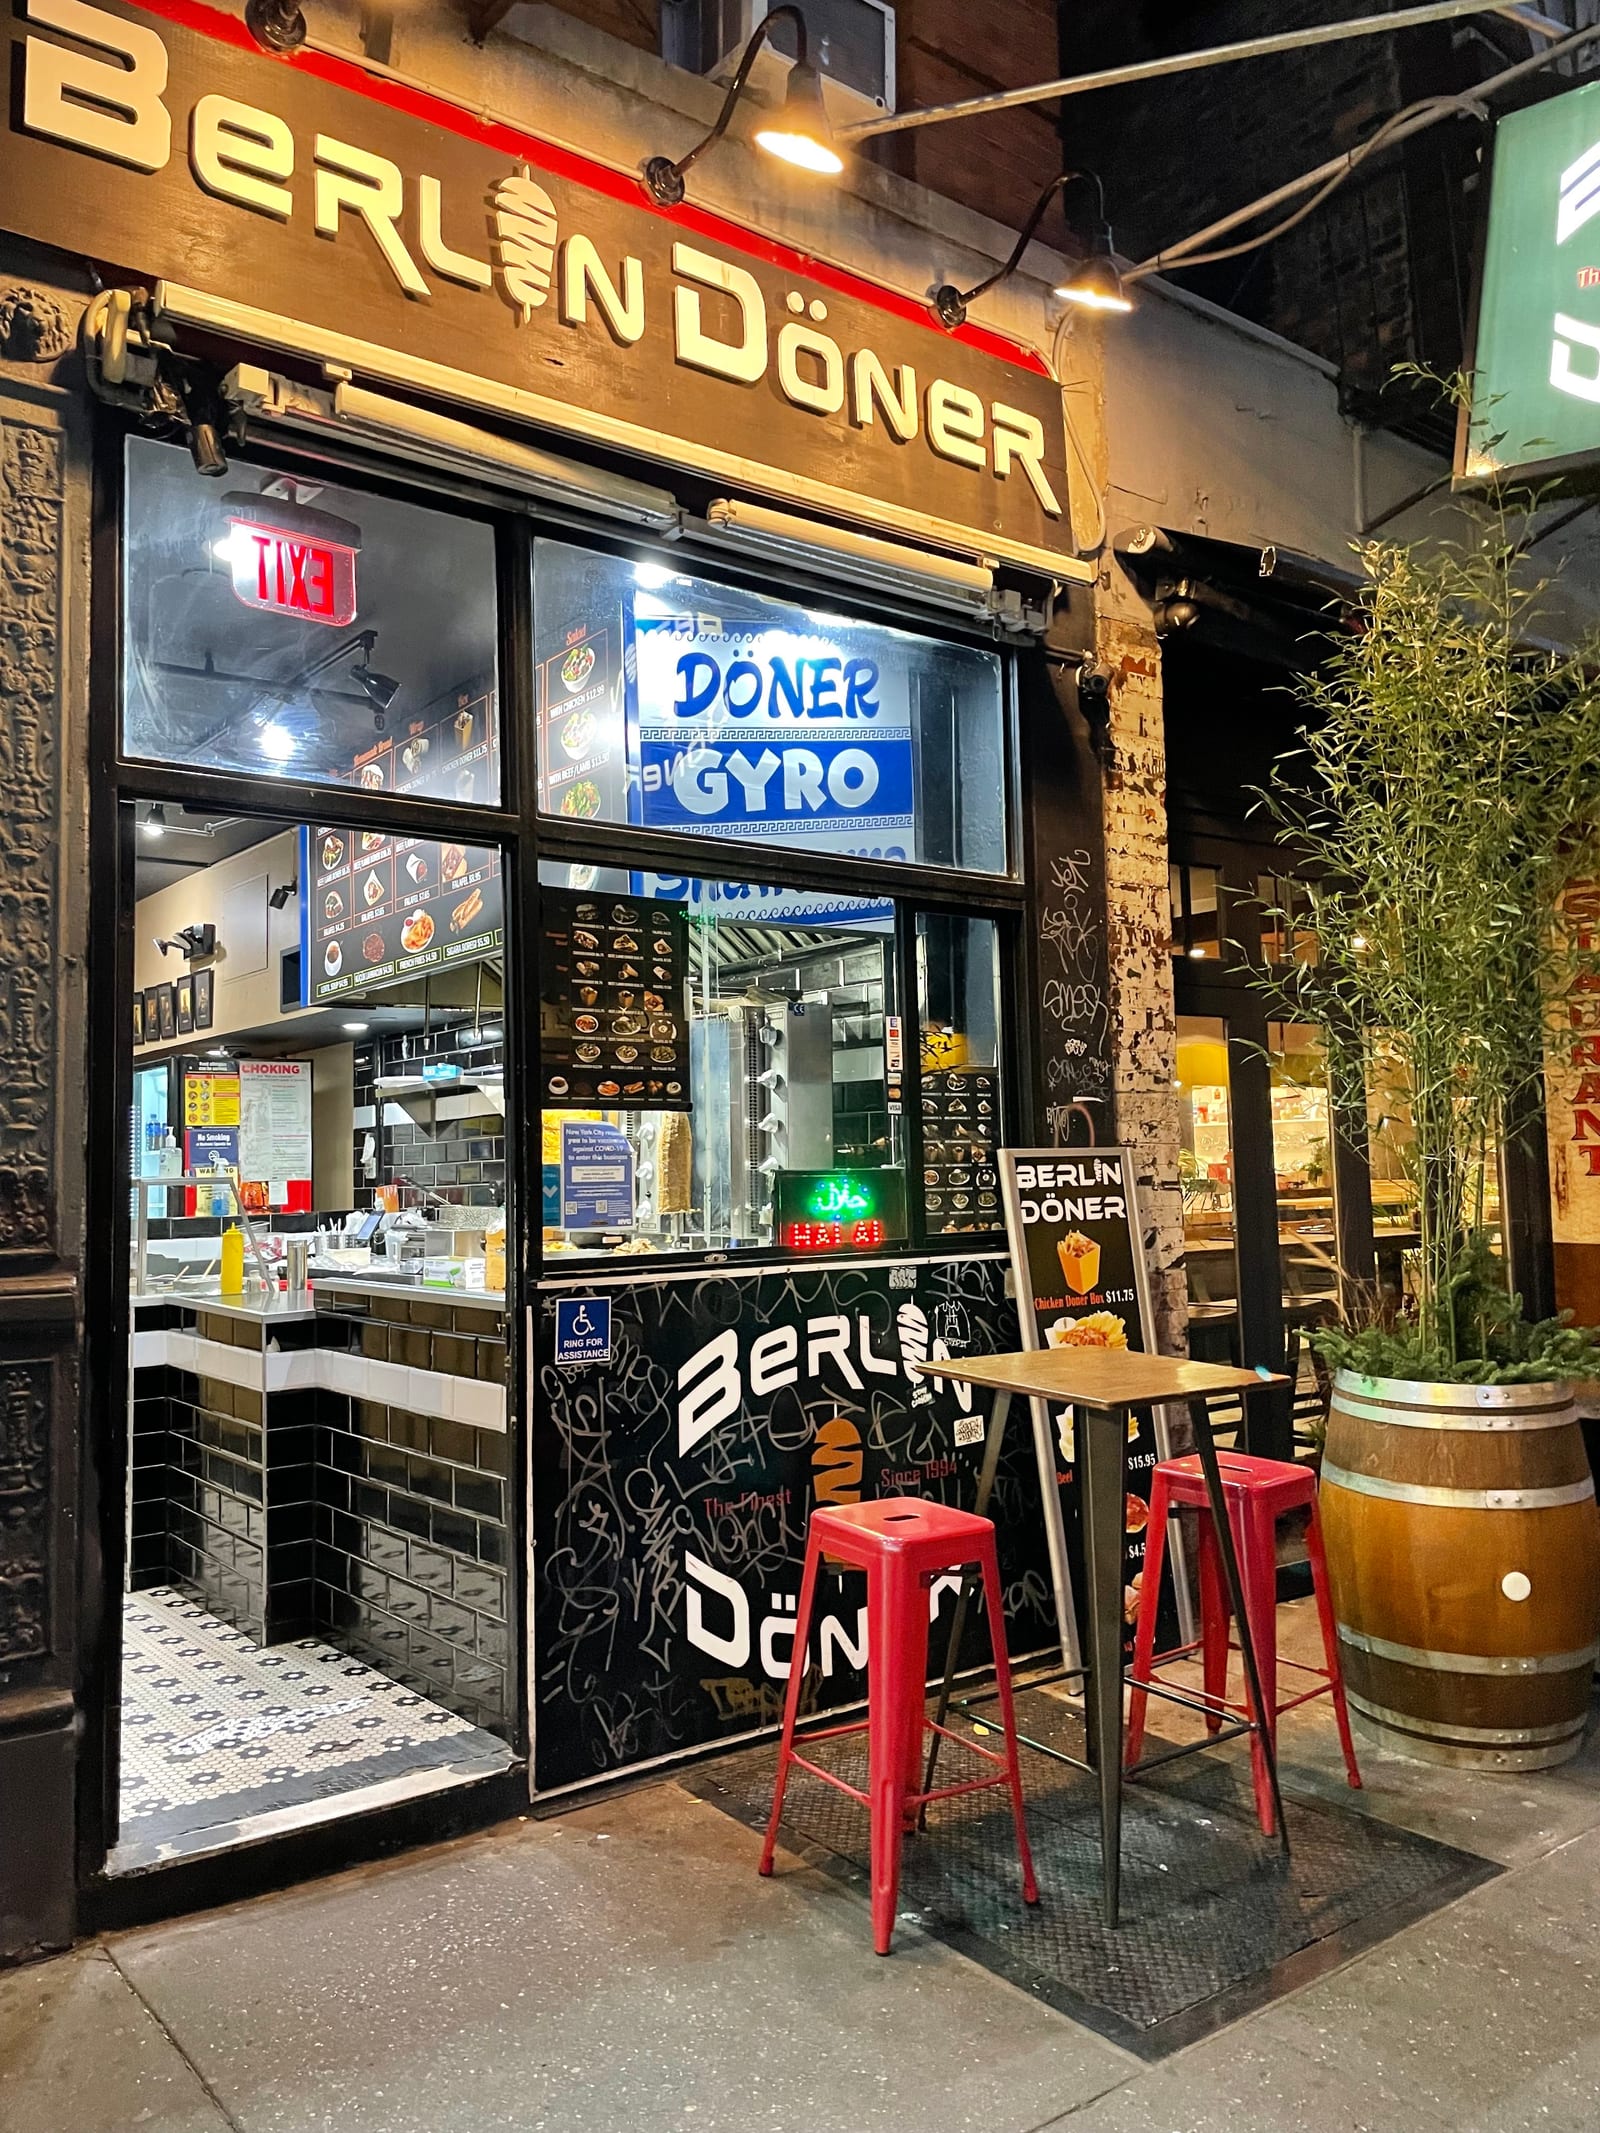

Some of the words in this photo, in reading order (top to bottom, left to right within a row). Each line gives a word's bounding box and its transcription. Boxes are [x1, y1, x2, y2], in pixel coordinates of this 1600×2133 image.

[675, 649, 880, 719] DÖNER
[673, 747, 880, 815] GYRO
[241, 1064, 300, 1075] CHOKING
[1016, 1158, 1122, 1189] BERLIN
[1020, 1193, 1126, 1224] DÖNER
[1034, 1297, 1064, 1311] Chicken
[1065, 1294, 1088, 1308] Doner
[1089, 1292, 1104, 1305] Box
[1105, 1288, 1135, 1304] $11.75
[558, 1349, 609, 1361] ASSISTANCE
[563, 1339, 584, 1348] RING
[586, 1338, 603, 1347] FOR
[881, 1466, 921, 1487] Since
[926, 1460, 957, 1479] 1994
[1127, 1453, 1156, 1470] $15.95
[704, 1498, 734, 1518] The
[741, 1488, 792, 1512] Finest
